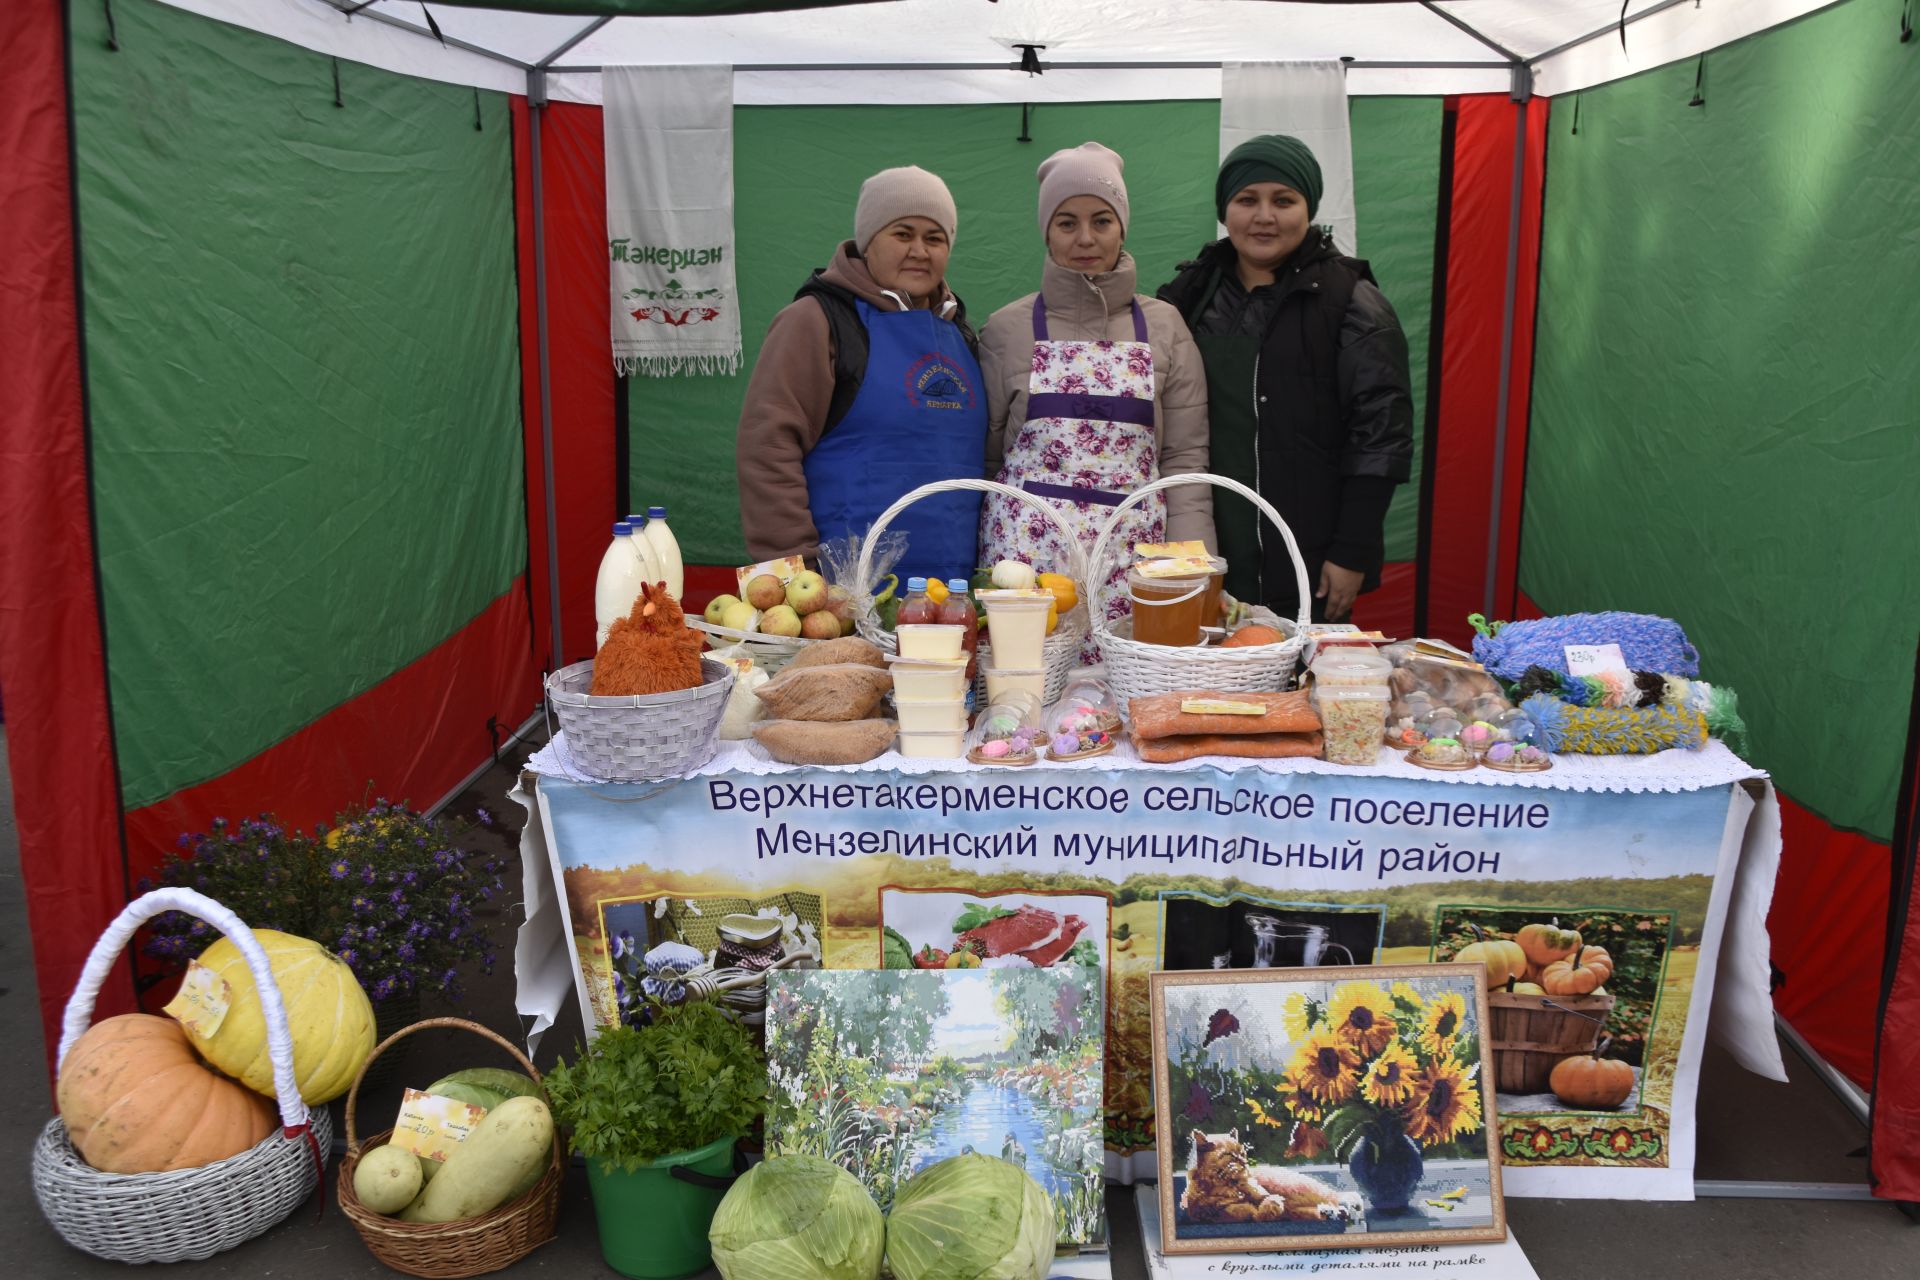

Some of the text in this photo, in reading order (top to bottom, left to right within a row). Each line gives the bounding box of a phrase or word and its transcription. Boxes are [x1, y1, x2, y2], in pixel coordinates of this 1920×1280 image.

[709, 780, 1549, 829] Верхнетакерменское сельское поселение
[756, 822, 1500, 880] Мензелинский муниципальный район
[1207, 1253, 1487, 1275] с круглыми деталями на рамке
